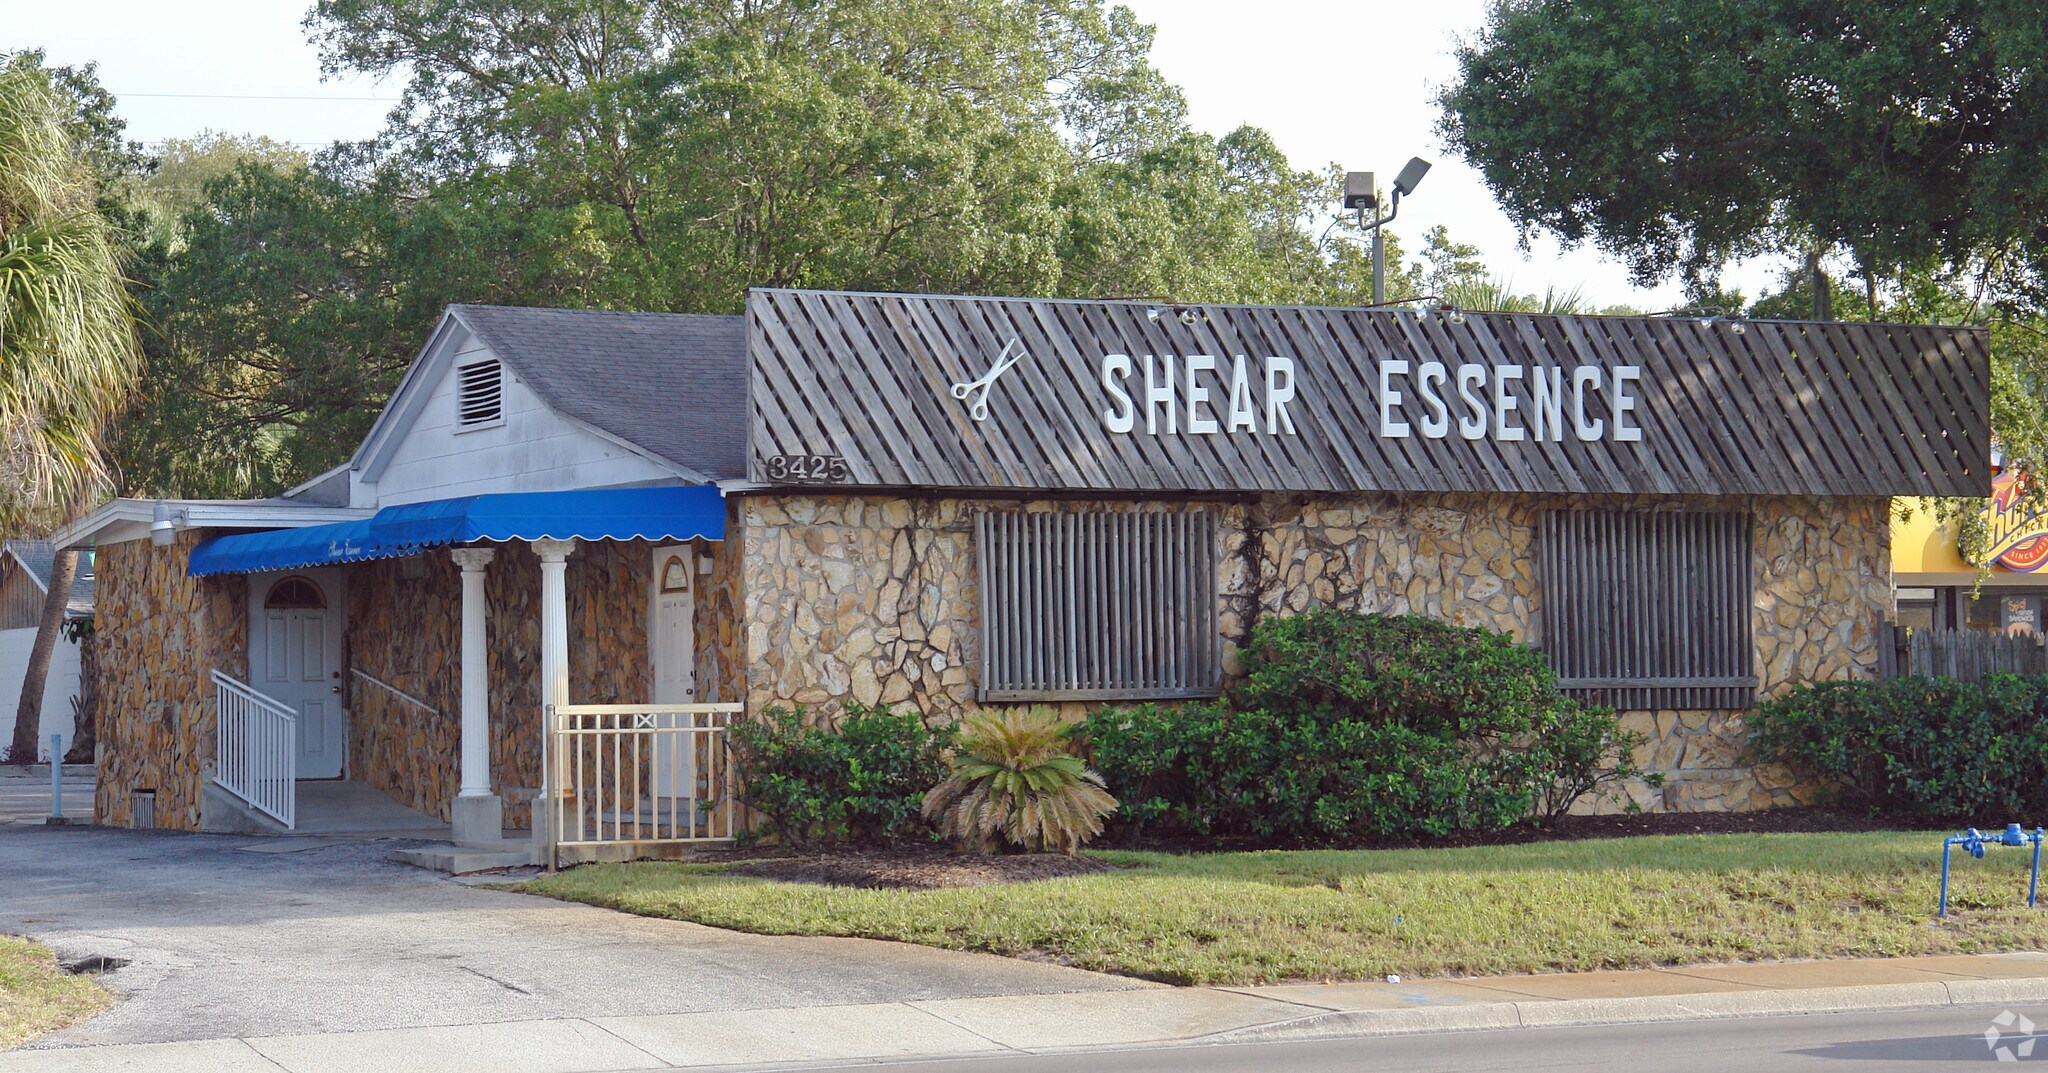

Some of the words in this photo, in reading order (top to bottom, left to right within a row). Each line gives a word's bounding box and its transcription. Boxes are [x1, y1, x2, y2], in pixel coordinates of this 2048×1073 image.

[1102, 354, 1296, 434] SHEAR
[1379, 360, 1642, 442] ESSENCE
[769, 455, 847, 480] 3425
[2010, 517, 2048, 543] CHICK
[2010, 550, 2034, 560] SINCE
